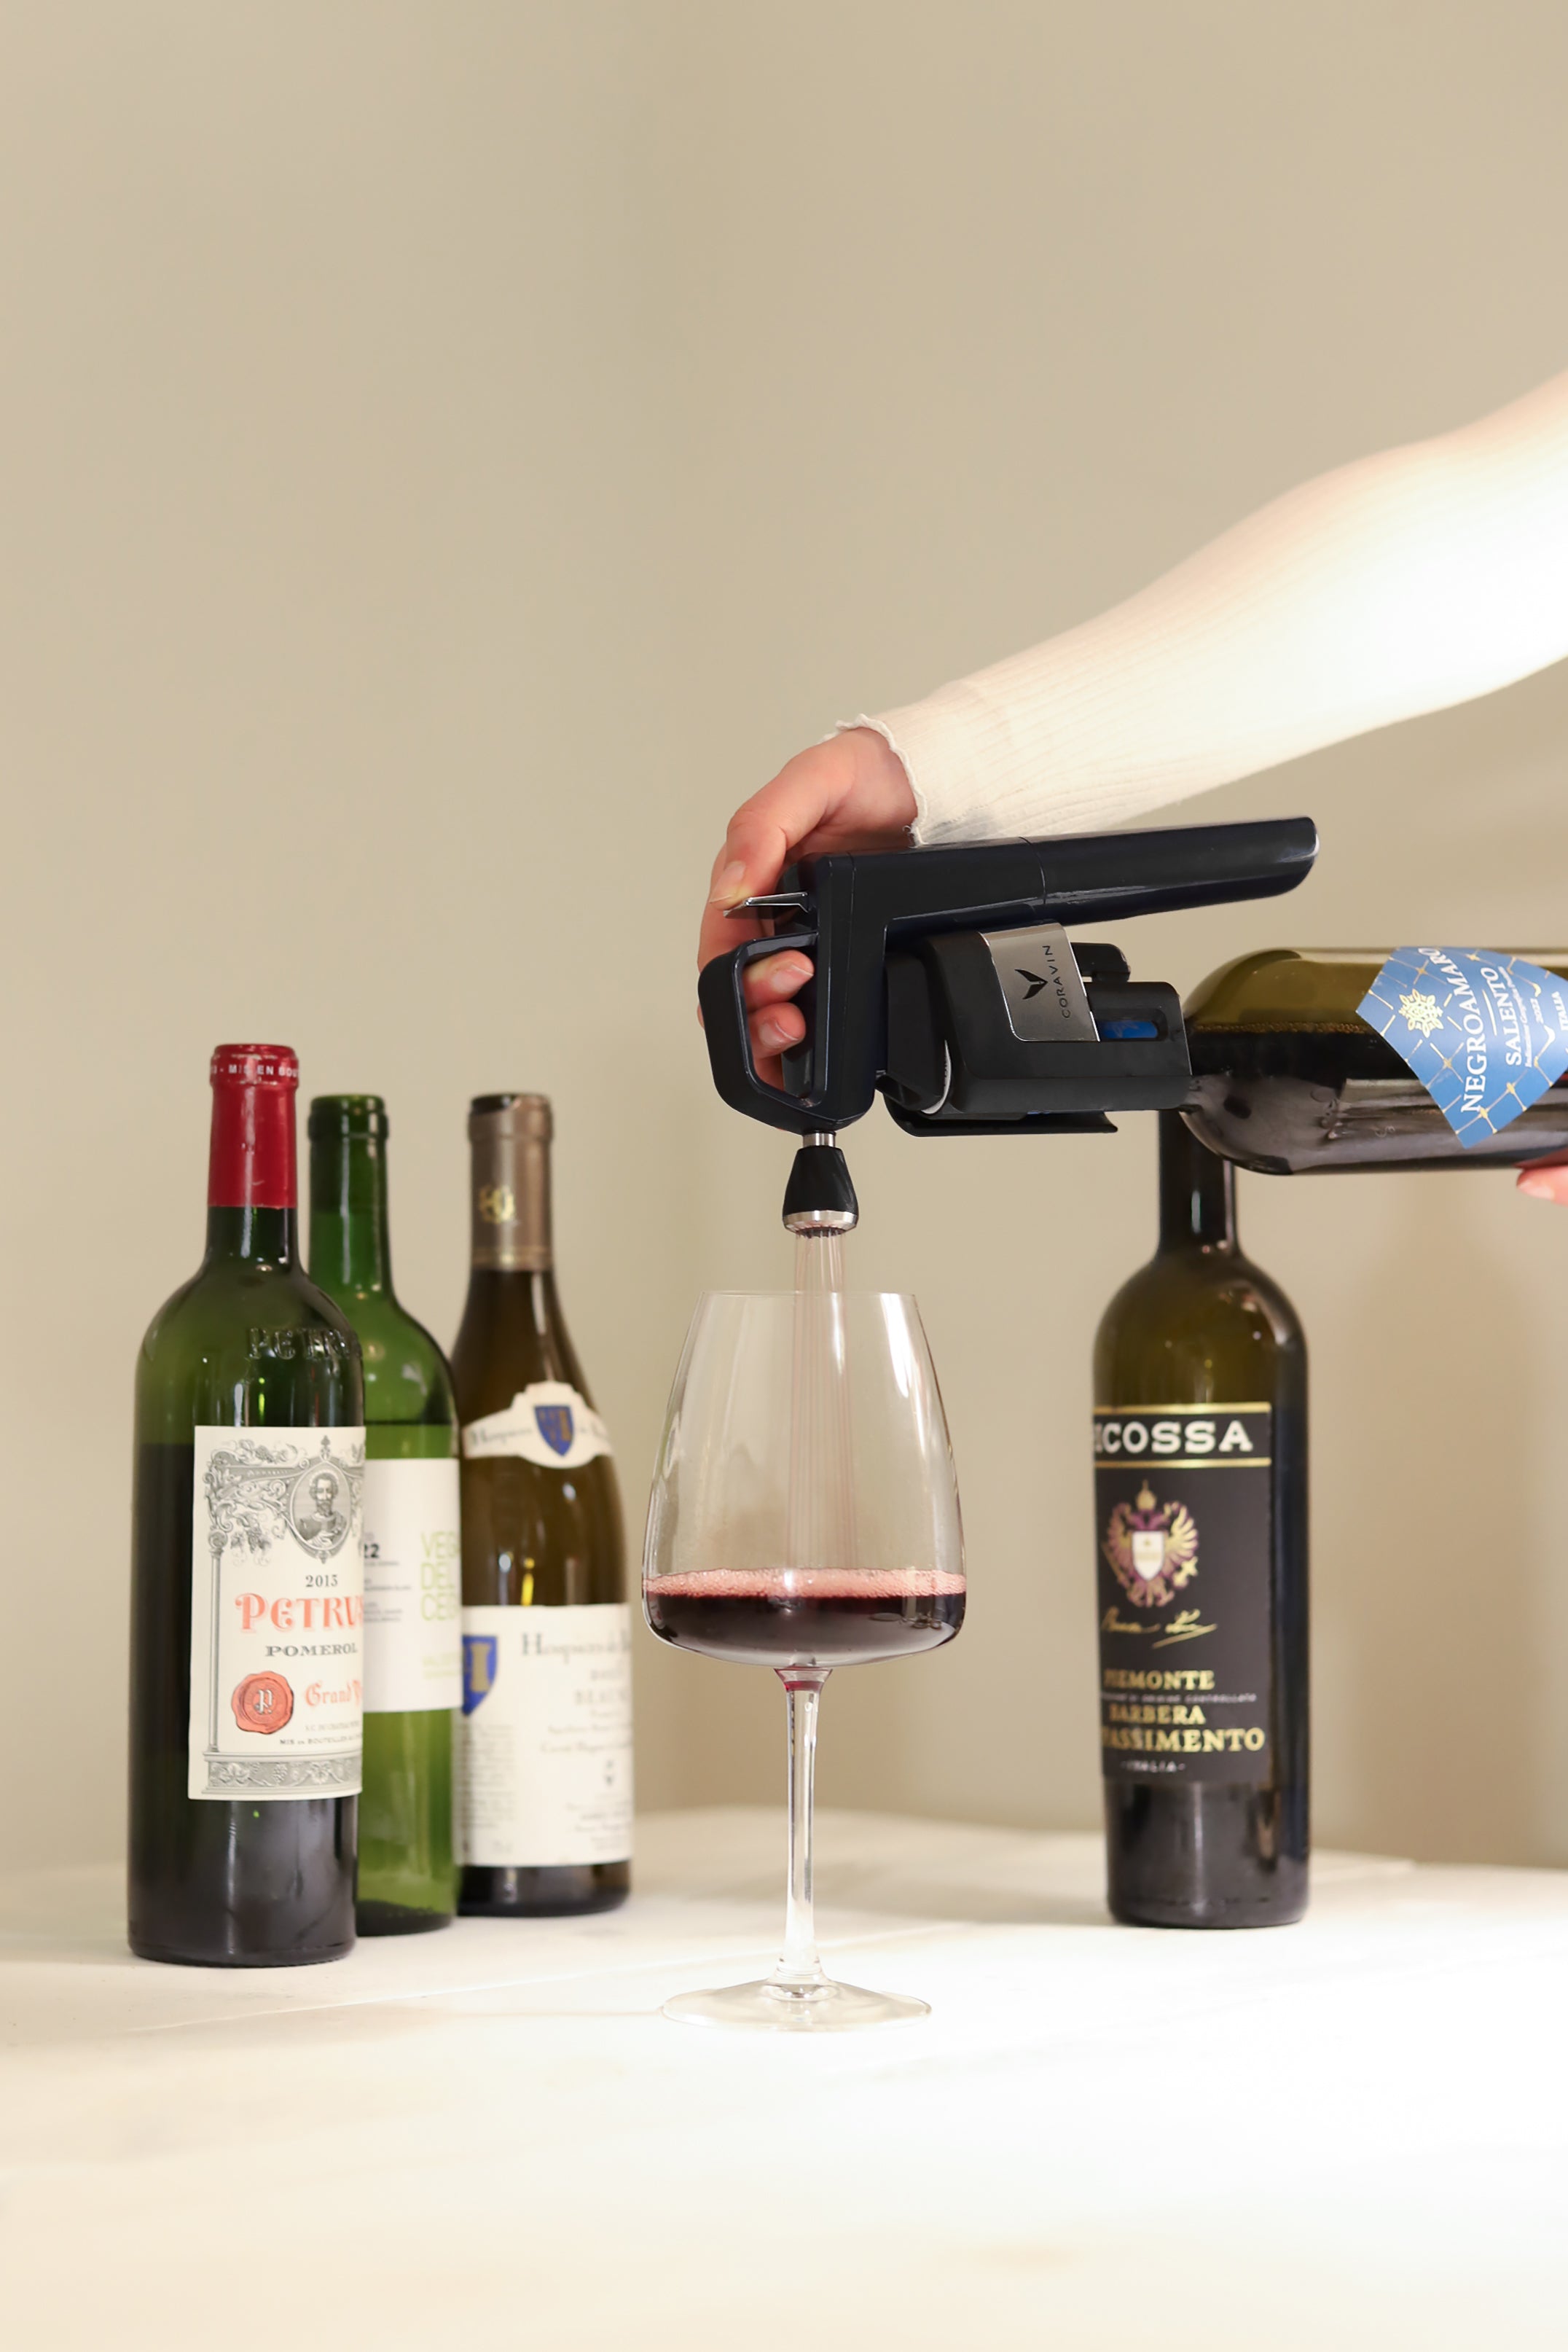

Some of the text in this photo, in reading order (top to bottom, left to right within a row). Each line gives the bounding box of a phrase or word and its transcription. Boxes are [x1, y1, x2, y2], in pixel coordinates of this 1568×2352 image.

[1042, 945, 1071, 1019] CORAVIN
[1480, 966, 1522, 1066] SALENTO
[1418, 948, 1488, 1113] NEGROAMARO
[256, 1064, 275, 1076] EN
[305, 1574, 339, 1588] 2015
[264, 1641, 358, 1658] POMEROL
[1108, 1702, 1207, 1725] BARBERA
